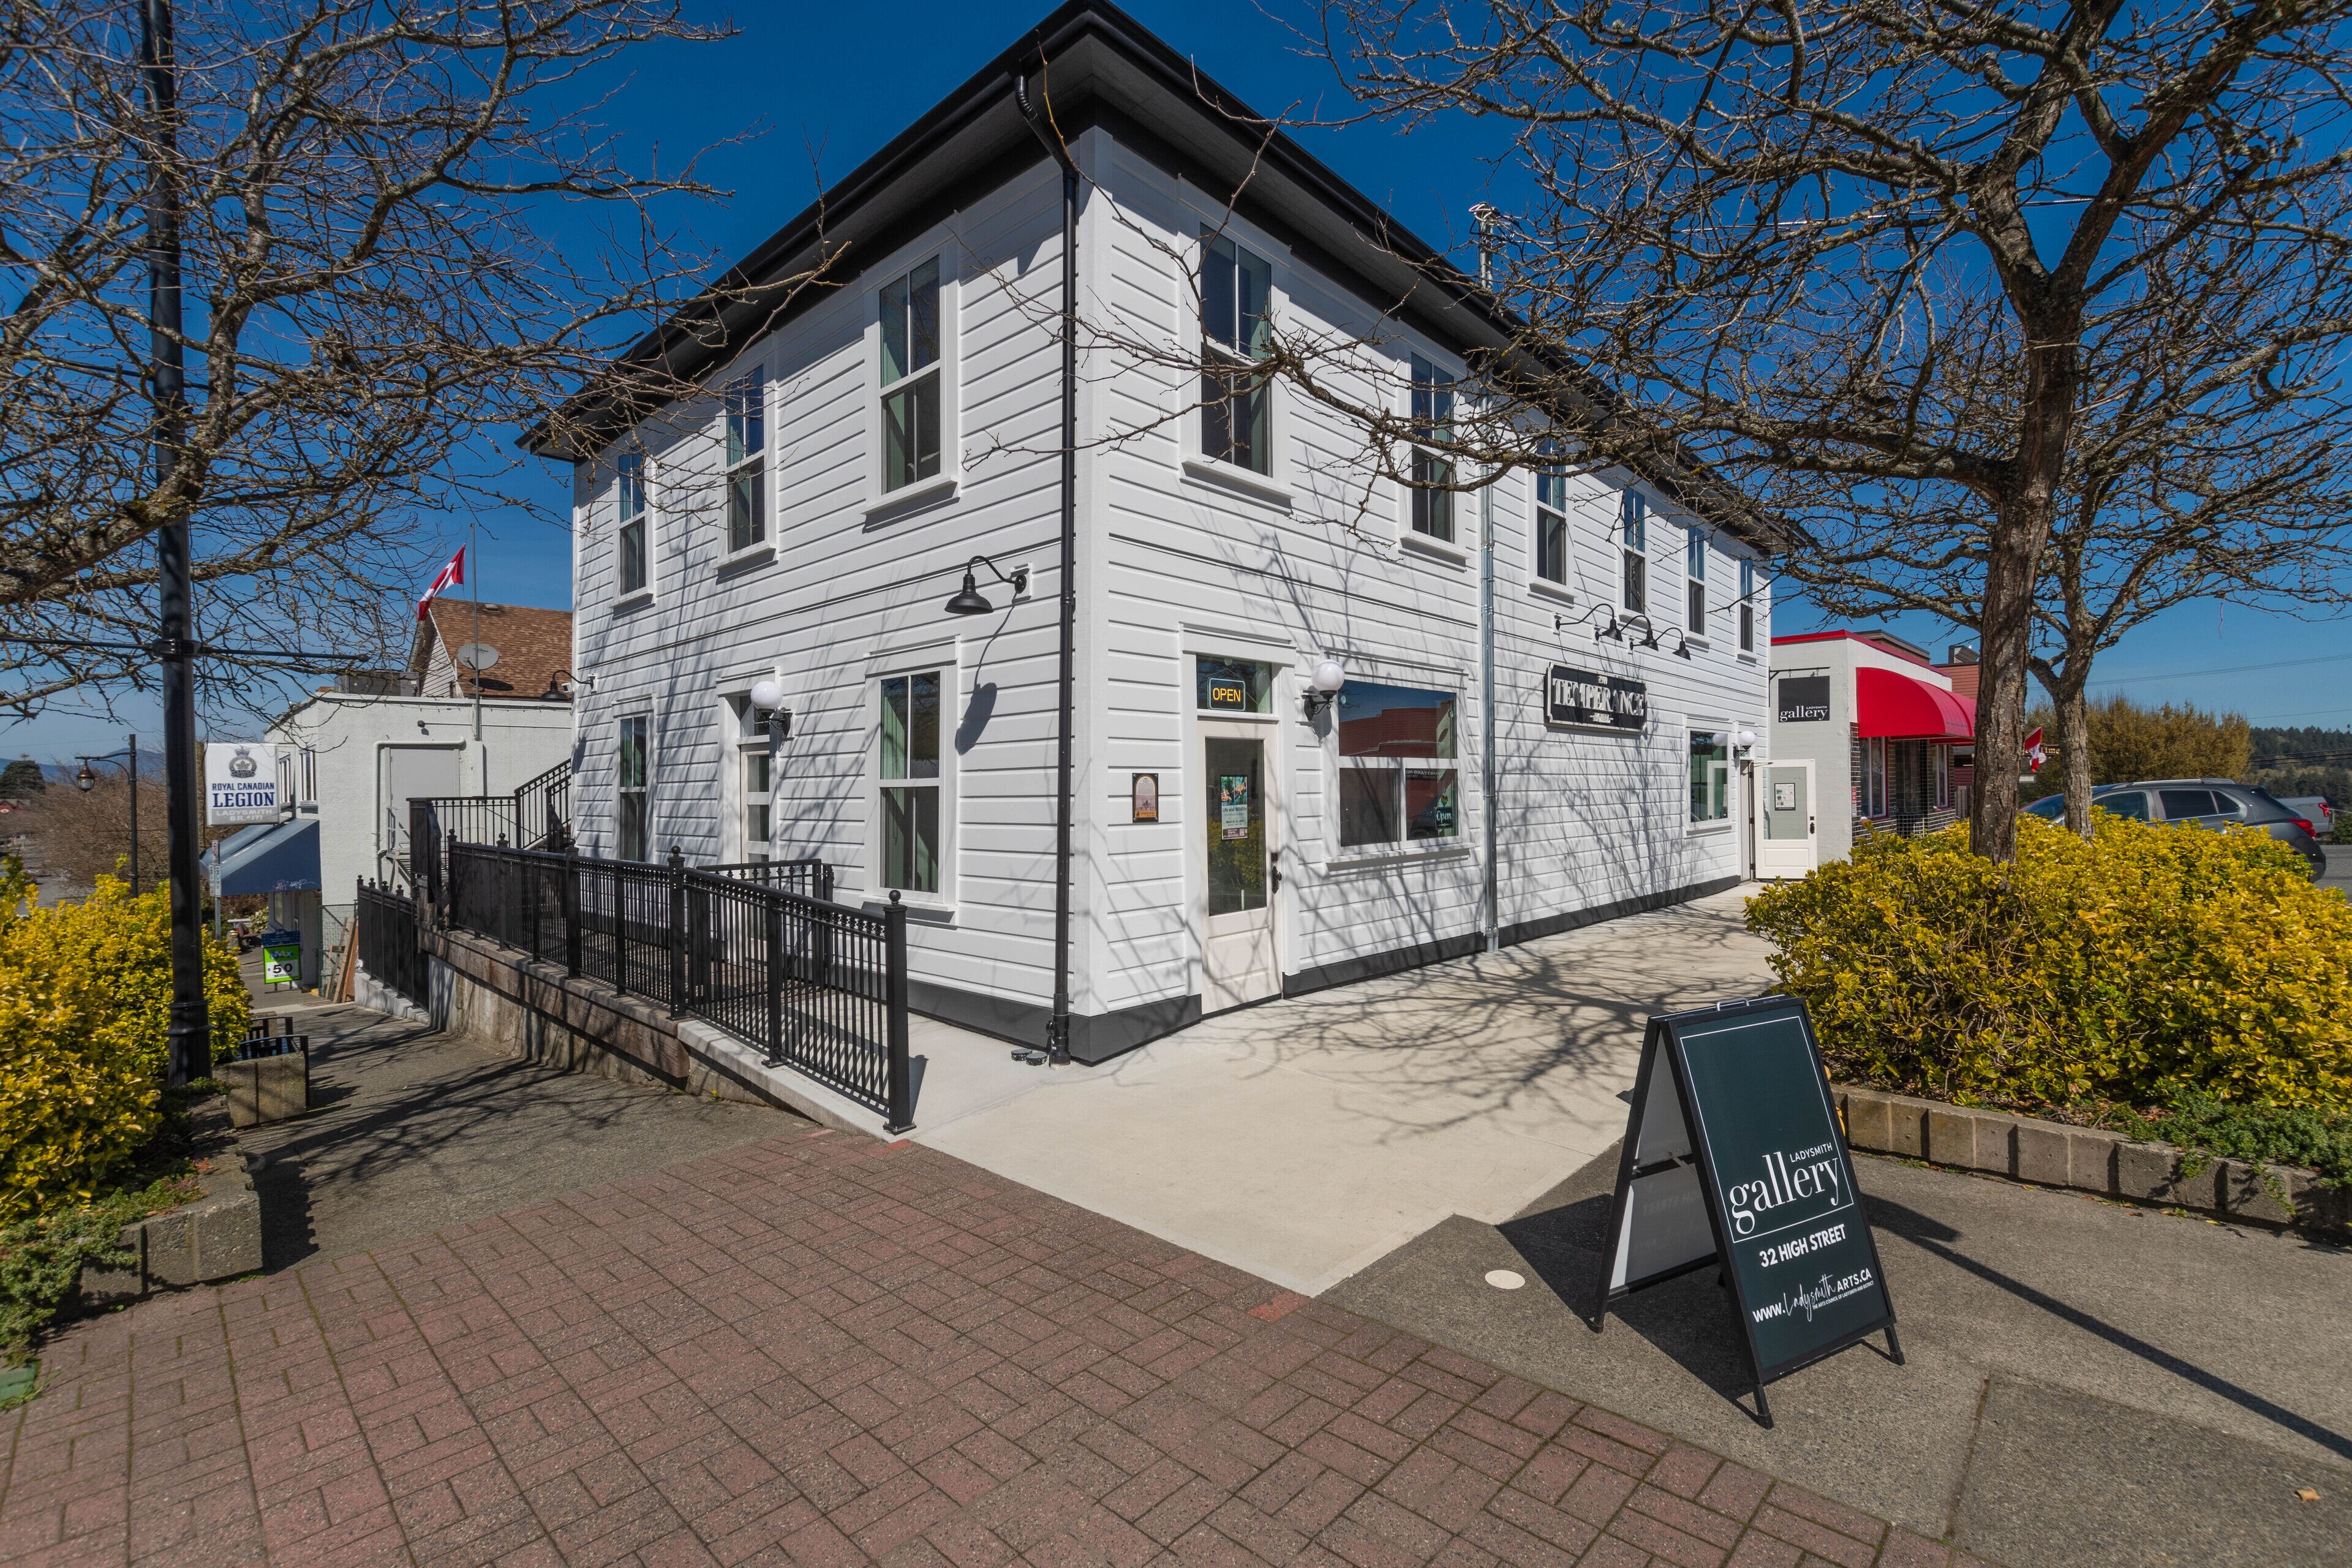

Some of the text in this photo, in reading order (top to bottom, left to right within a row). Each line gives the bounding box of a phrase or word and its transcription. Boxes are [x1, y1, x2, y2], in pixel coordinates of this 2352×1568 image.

[1212, 687, 1241, 702] OPEN
[1552, 677, 1644, 717] TEMPERANCE
[1780, 706, 1828, 722] gallery
[238, 782, 274, 791] CANADIAN
[213, 792, 275, 807] LEGION
[1436, 810, 1452, 823] Open
[1789, 1142, 1833, 1163] LADYSMITH
[1729, 1151, 1838, 1234] gallery
[1759, 1223, 1846, 1267] 32 HIGH STREET
